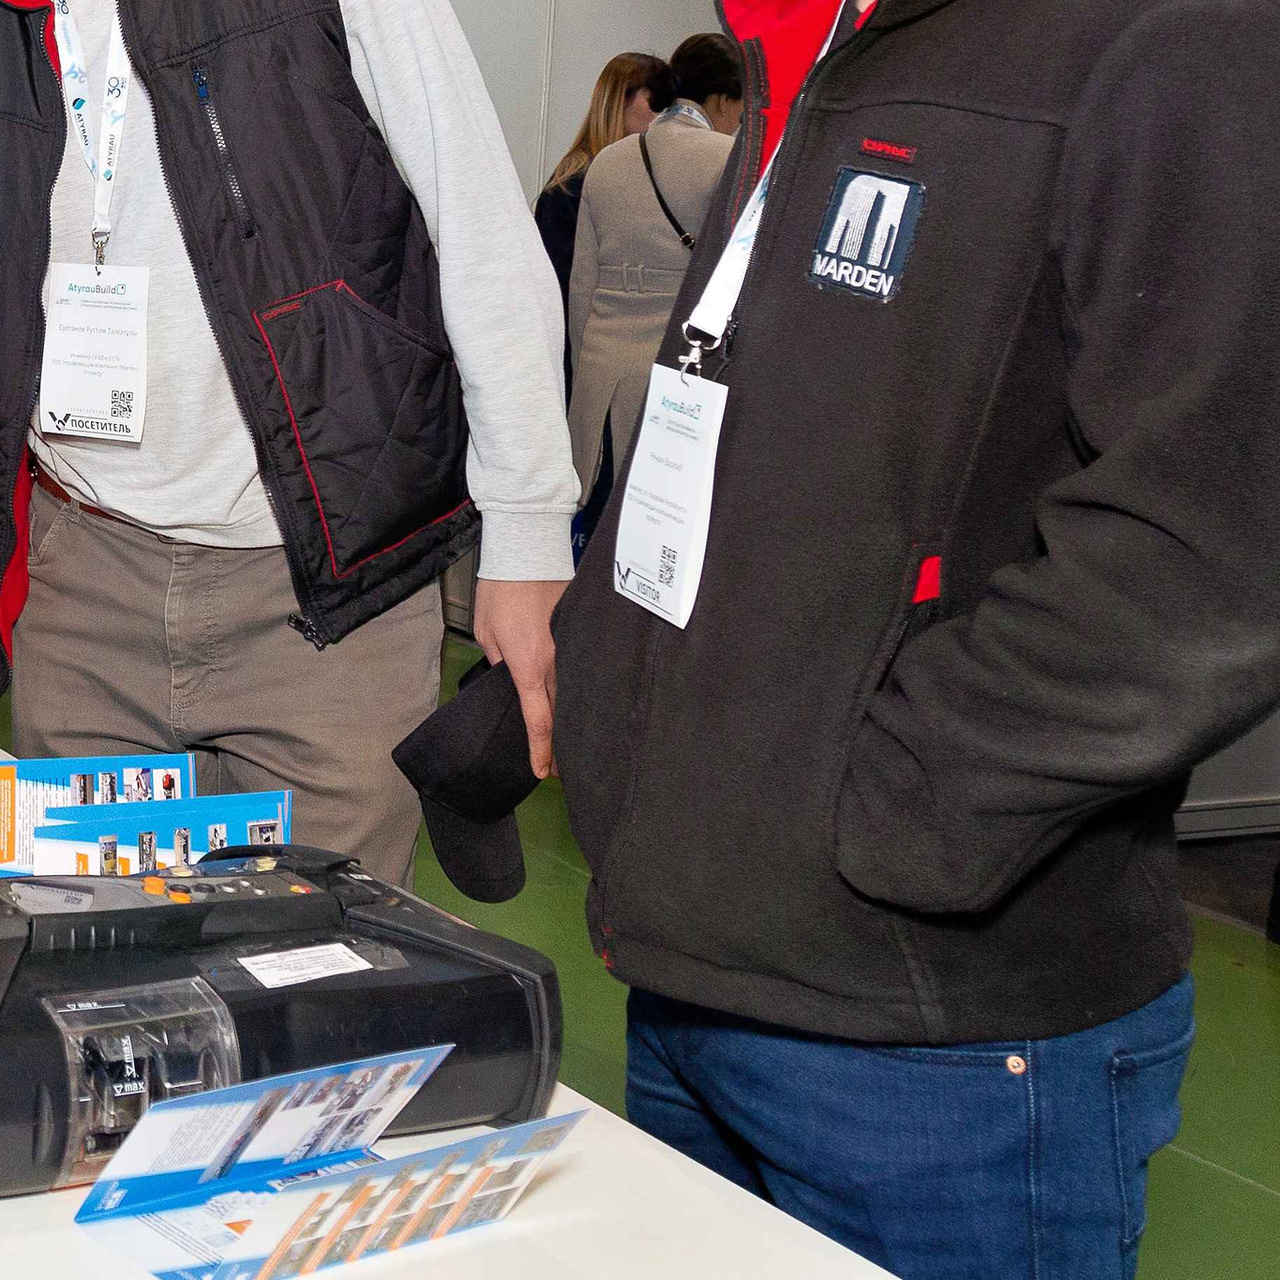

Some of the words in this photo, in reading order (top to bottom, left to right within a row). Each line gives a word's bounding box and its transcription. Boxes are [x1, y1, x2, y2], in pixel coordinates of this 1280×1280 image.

[75, 112, 89, 147] ATYRAU
[68, 283, 117, 295] AtyrauBuild
[71, 418, 132, 434] ПОСЕТИТЕЛЬ
